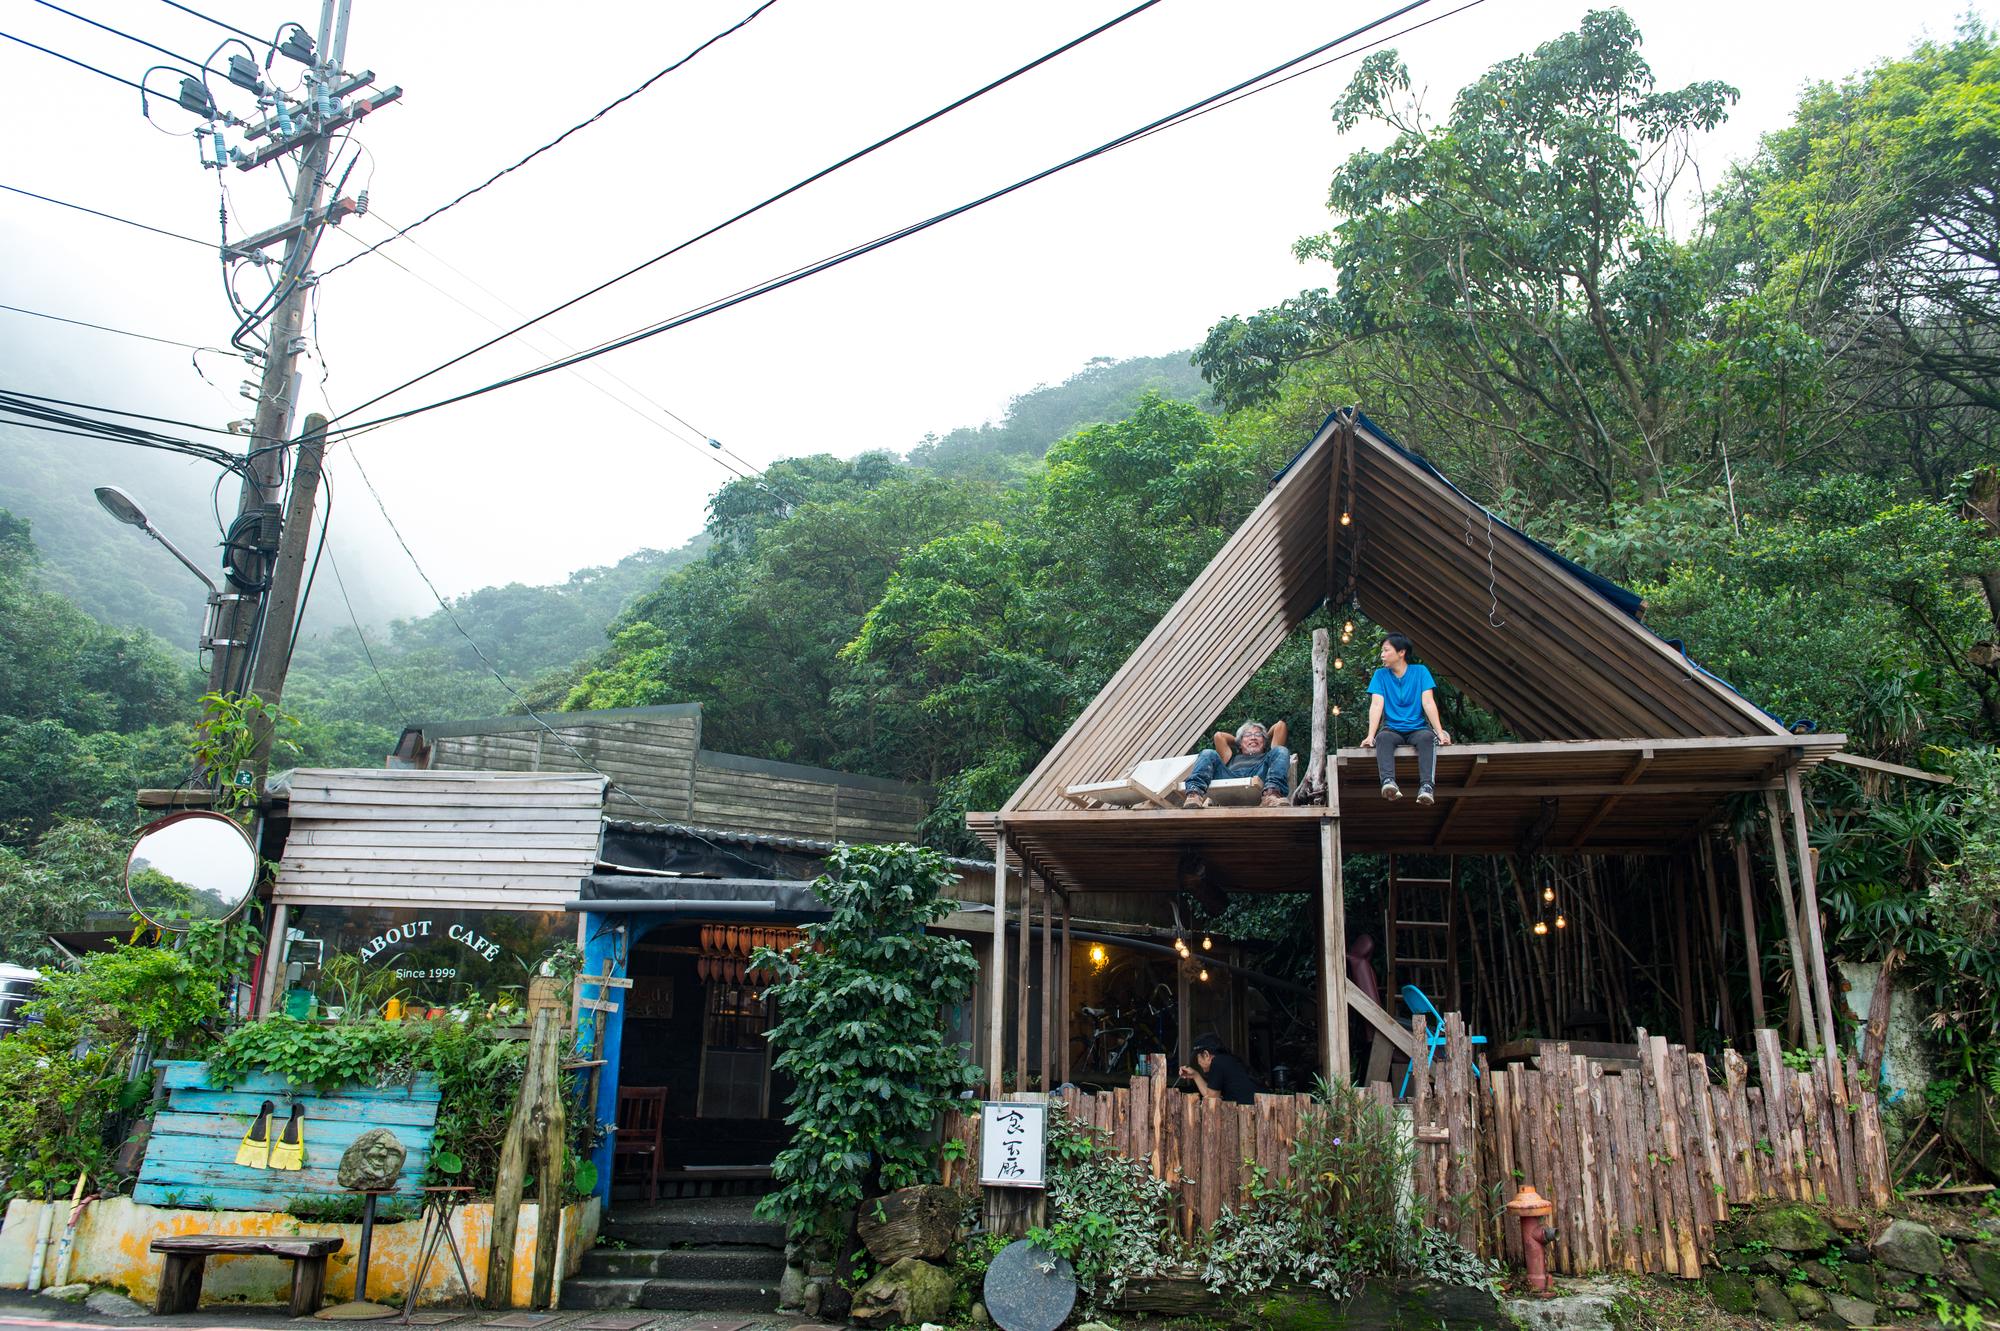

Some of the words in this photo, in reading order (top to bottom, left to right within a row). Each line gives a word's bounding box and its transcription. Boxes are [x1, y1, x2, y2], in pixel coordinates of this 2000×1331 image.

[360, 920, 432, 963] ABOUT
[449, 924, 500, 962] CAFÉ
[396, 968, 425, 978] Since
[429, 968, 456, 978] 1999
